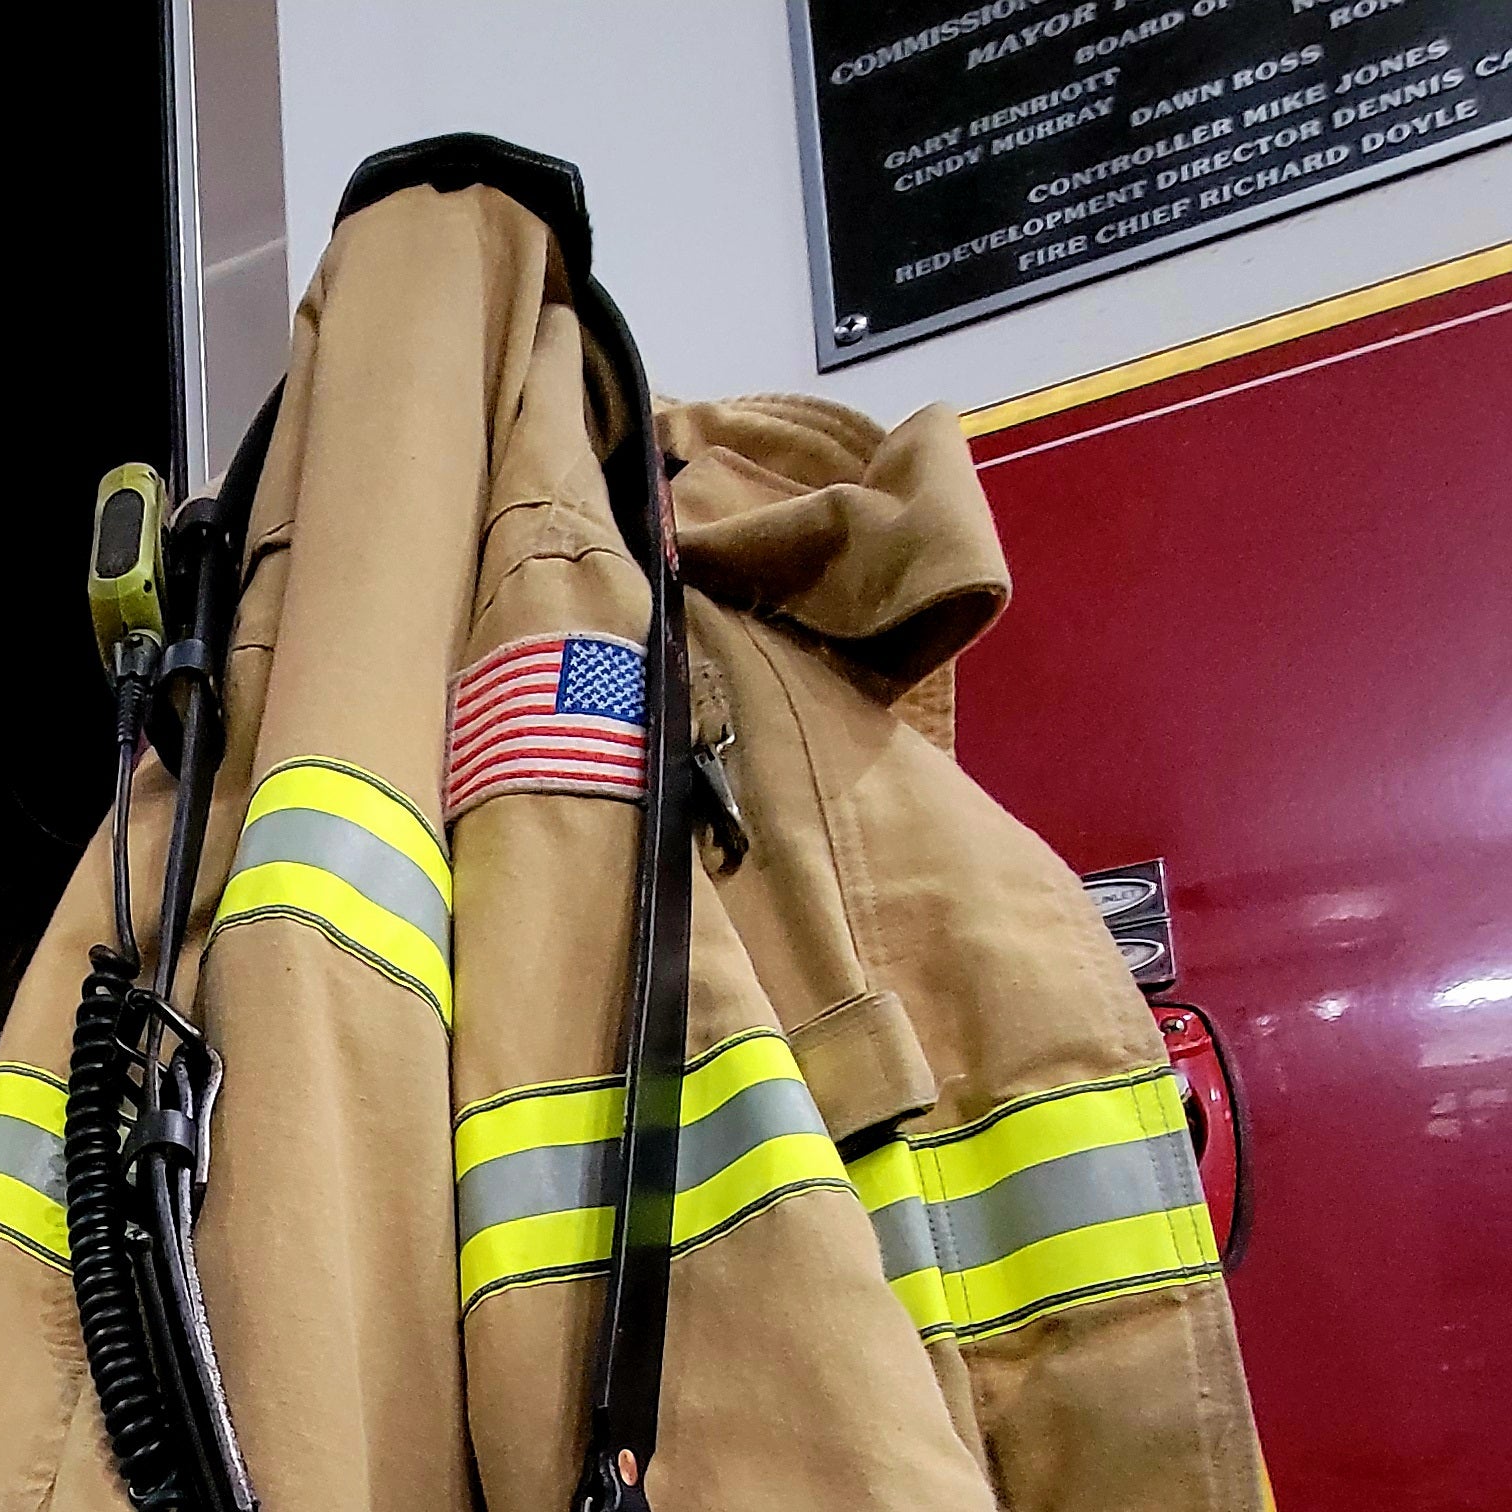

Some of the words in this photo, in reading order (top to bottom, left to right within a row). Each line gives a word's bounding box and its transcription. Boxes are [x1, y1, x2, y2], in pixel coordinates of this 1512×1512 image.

[967, 2, 1097, 70] MAYOR
[1074, 11, 1185, 65] BOARD
[884, 126, 962, 168] GARY
[969, 66, 1121, 136] HENRIOTT
[1027, 117, 1233, 203] CONTROLLER
[1242, 82, 1328, 128] MIKE
[1335, 39, 1451, 94] JONES
[1129, 78, 1225, 127] DAWN
[1232, 44, 1325, 90] ROSS
[894, 145, 983, 191] CINDY
[991, 96, 1116, 155] MURRAY
[895, 180, 1147, 284] REDEVELOPMENT
[1155, 118, 1322, 190] DIRECTOR
[1333, 68, 1466, 129] DENNIS
[1017, 235, 1088, 271] FIRE
[1095, 199, 1191, 244] CHIEF
[1199, 145, 1349, 210] RICHARD
[1361, 99, 1479, 153] DOYLE
